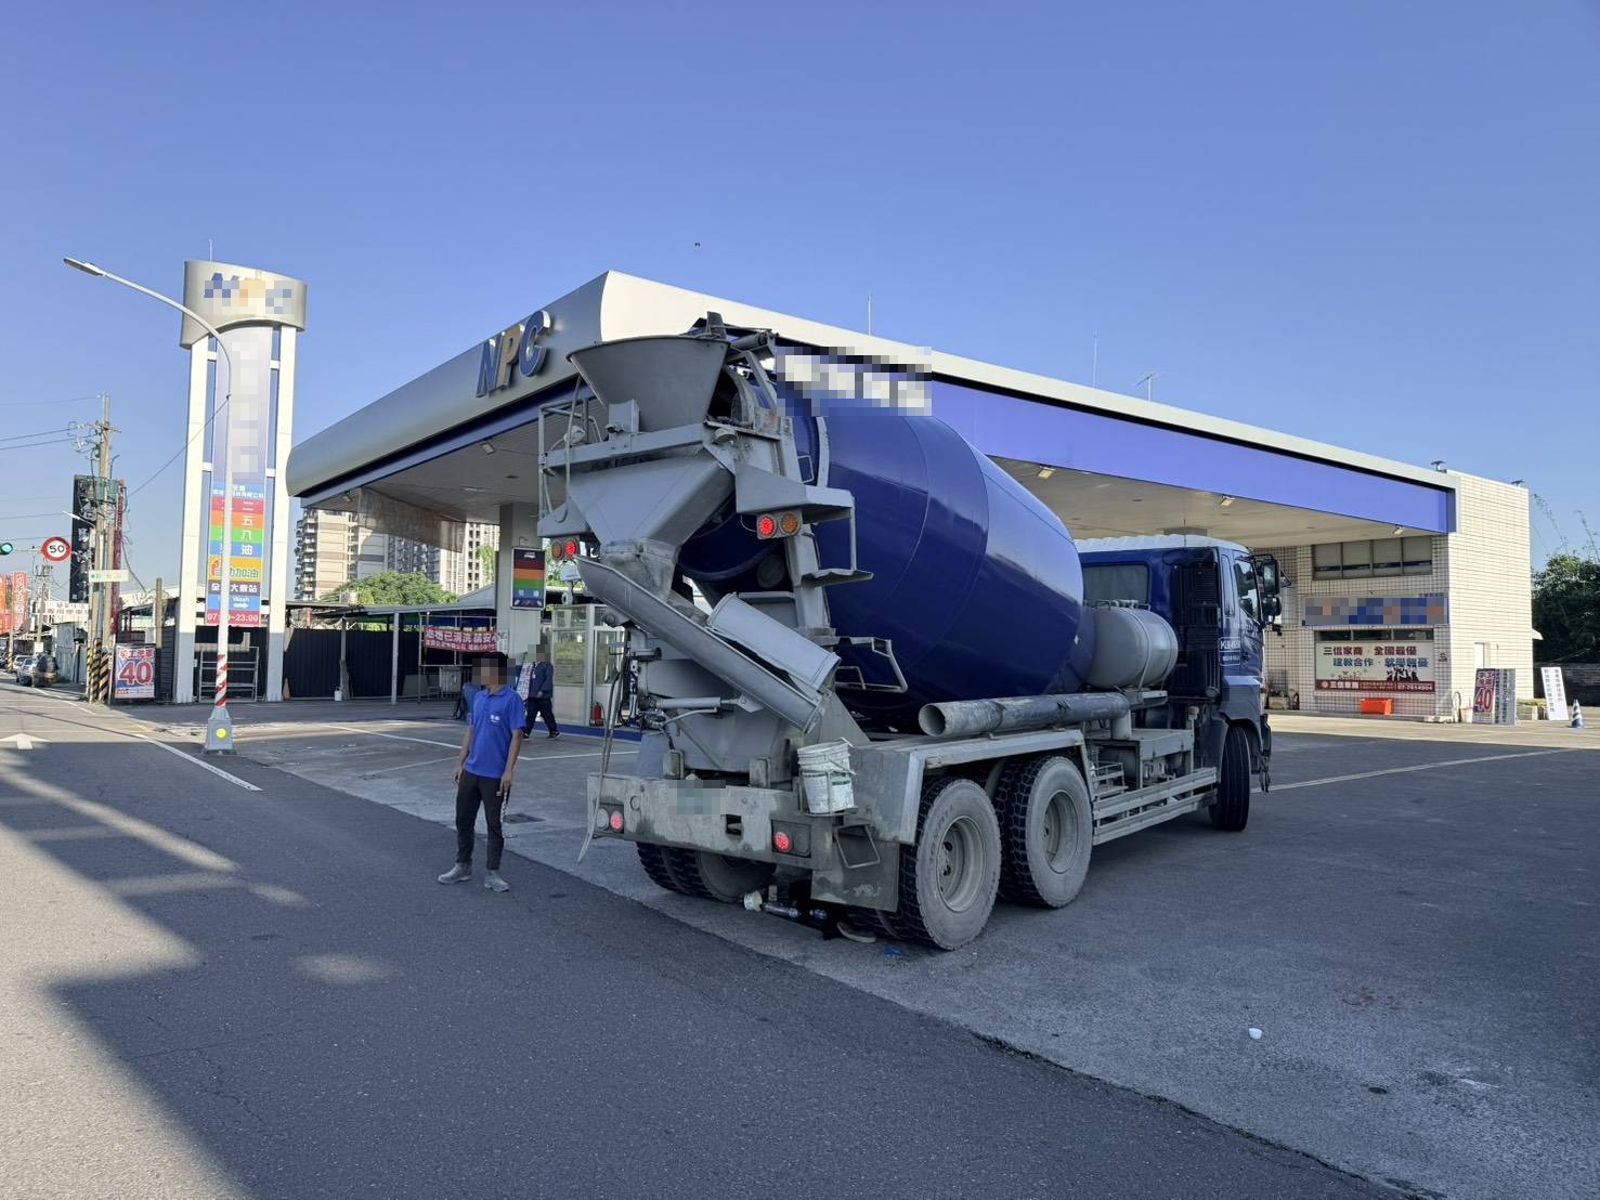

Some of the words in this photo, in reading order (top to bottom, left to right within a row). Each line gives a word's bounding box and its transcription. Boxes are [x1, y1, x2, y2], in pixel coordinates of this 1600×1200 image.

[476, 310, 551, 397] NPC
[49, 544, 64, 553] 50
[119, 661, 153, 685] 40
[1475, 687, 1493, 711] 40
